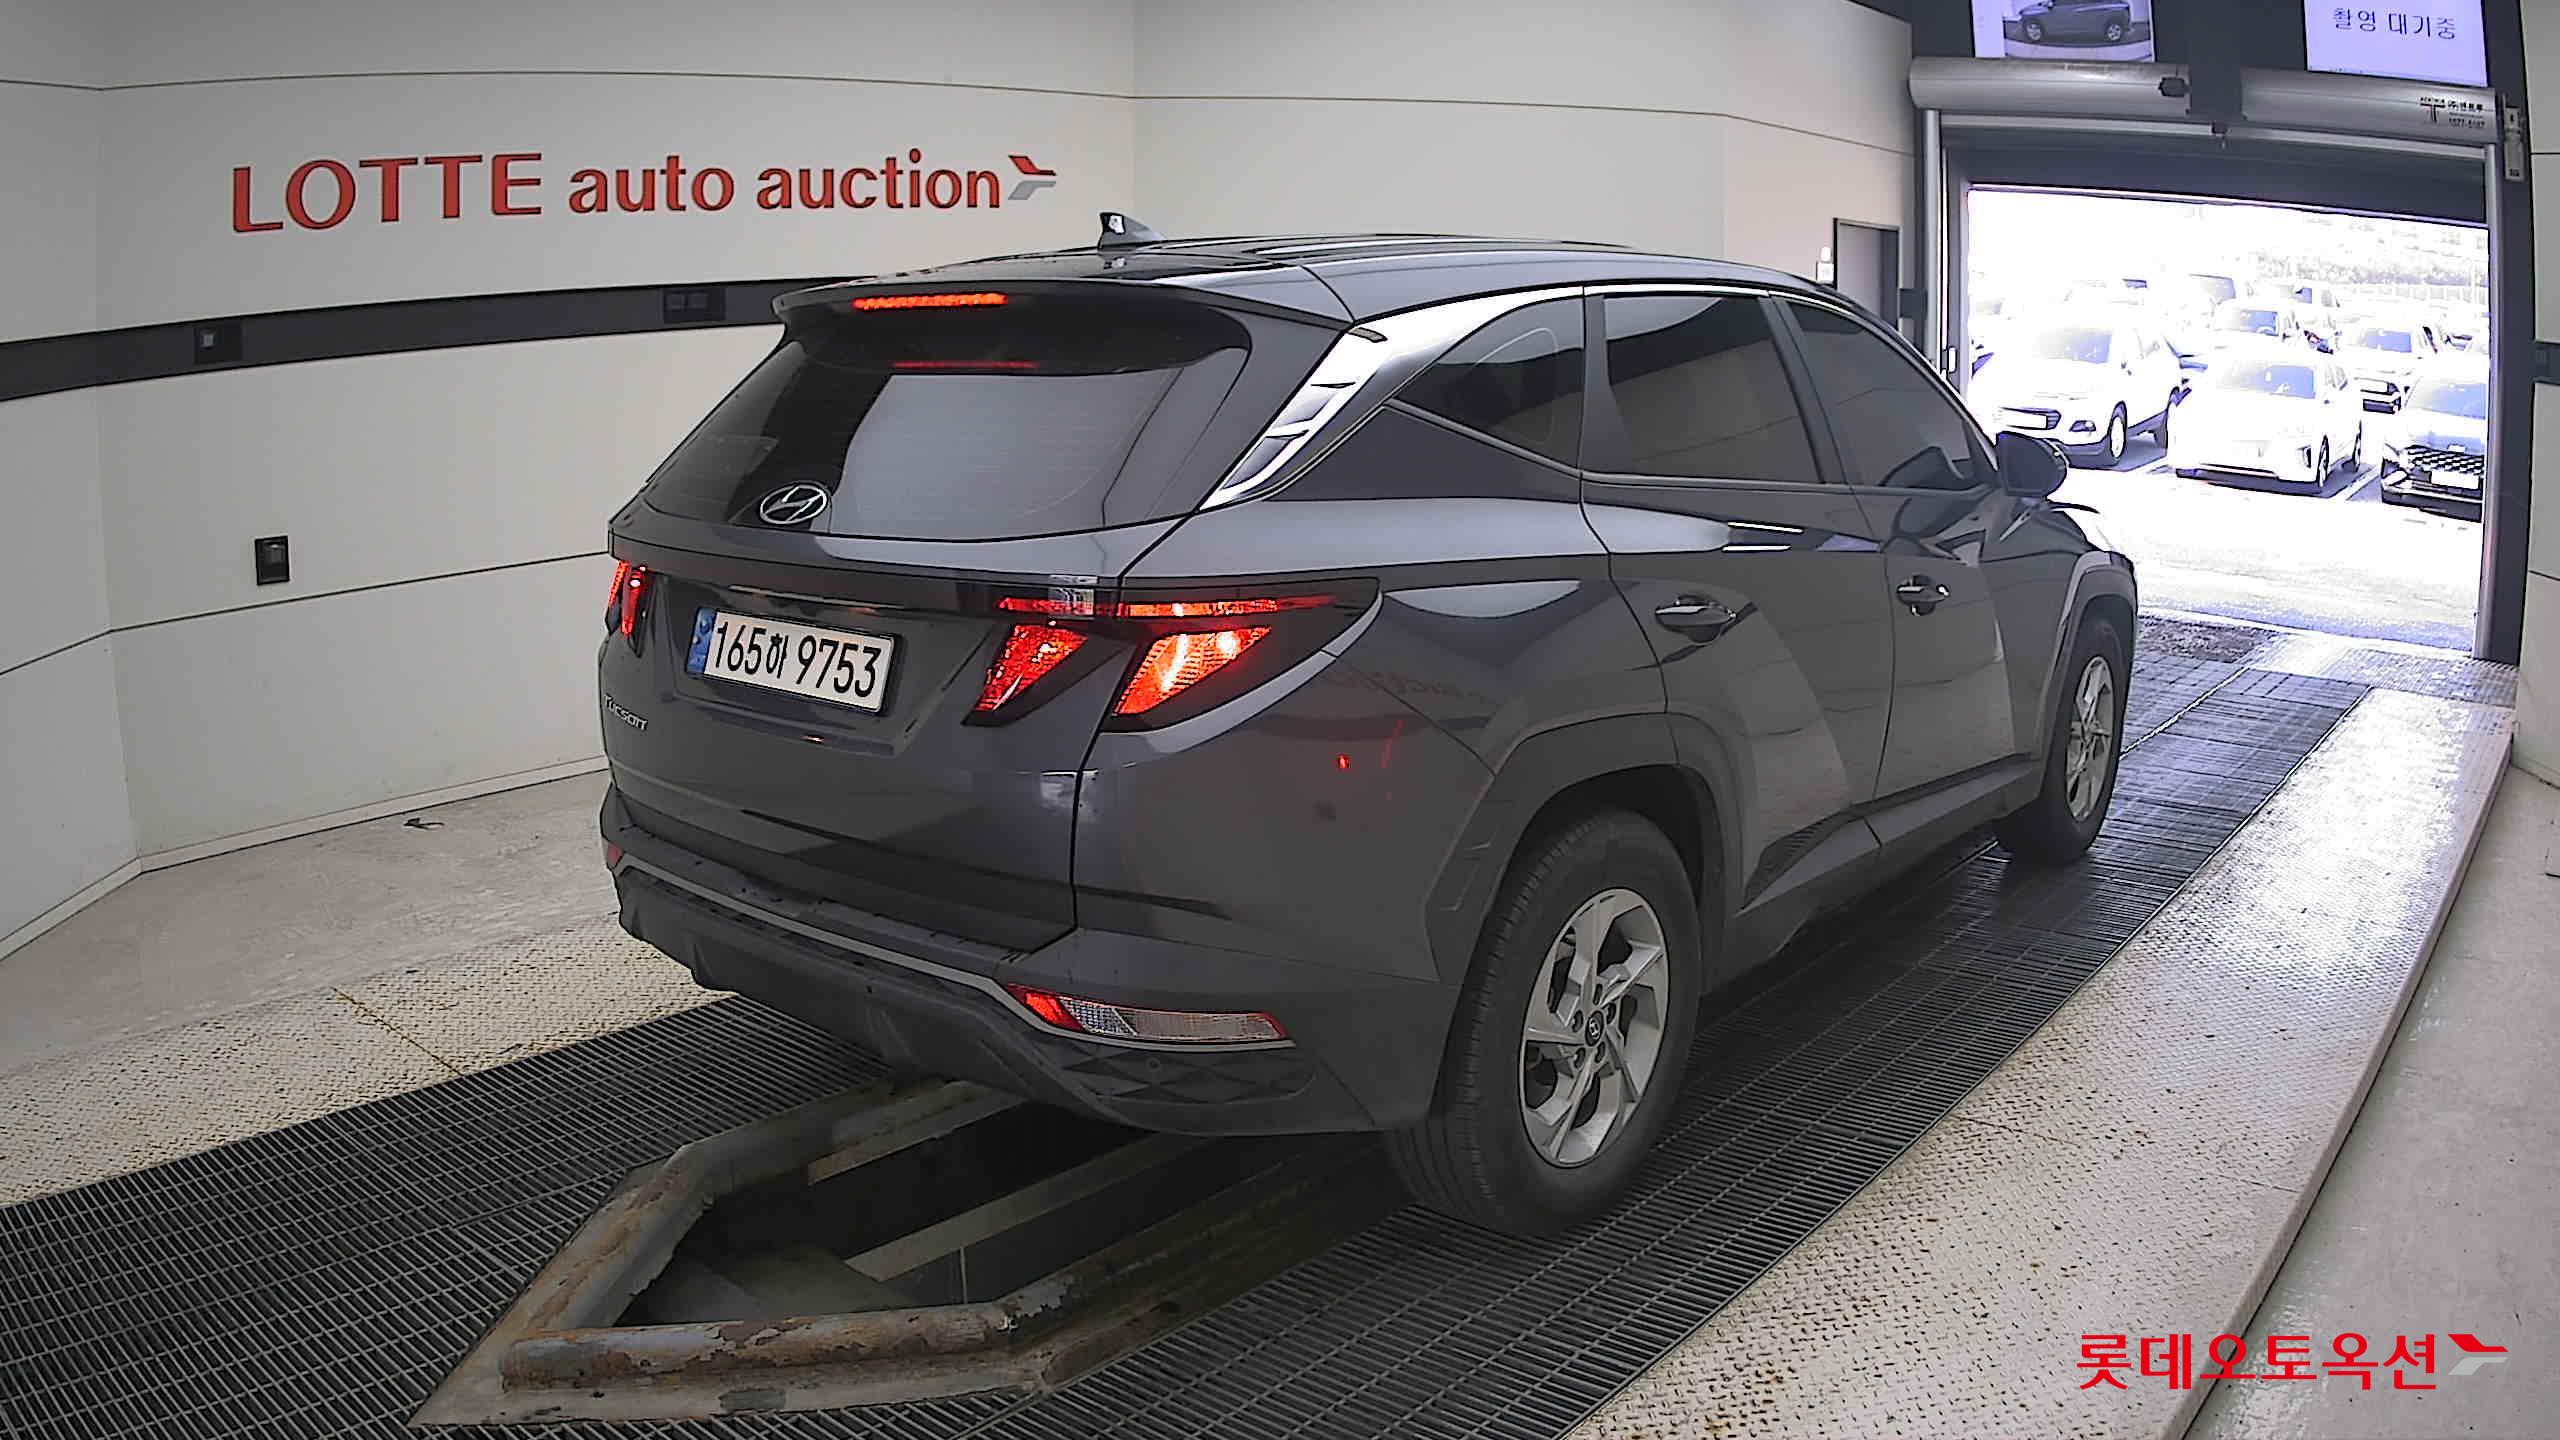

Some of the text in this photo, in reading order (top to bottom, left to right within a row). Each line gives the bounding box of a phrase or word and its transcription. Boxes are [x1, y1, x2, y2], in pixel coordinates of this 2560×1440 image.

[2333, 7, 2457, 40] 촬영 대기중
[232, 147, 1001, 233] LOTTE auto auction
[715, 621, 882, 698] 165하 9753
